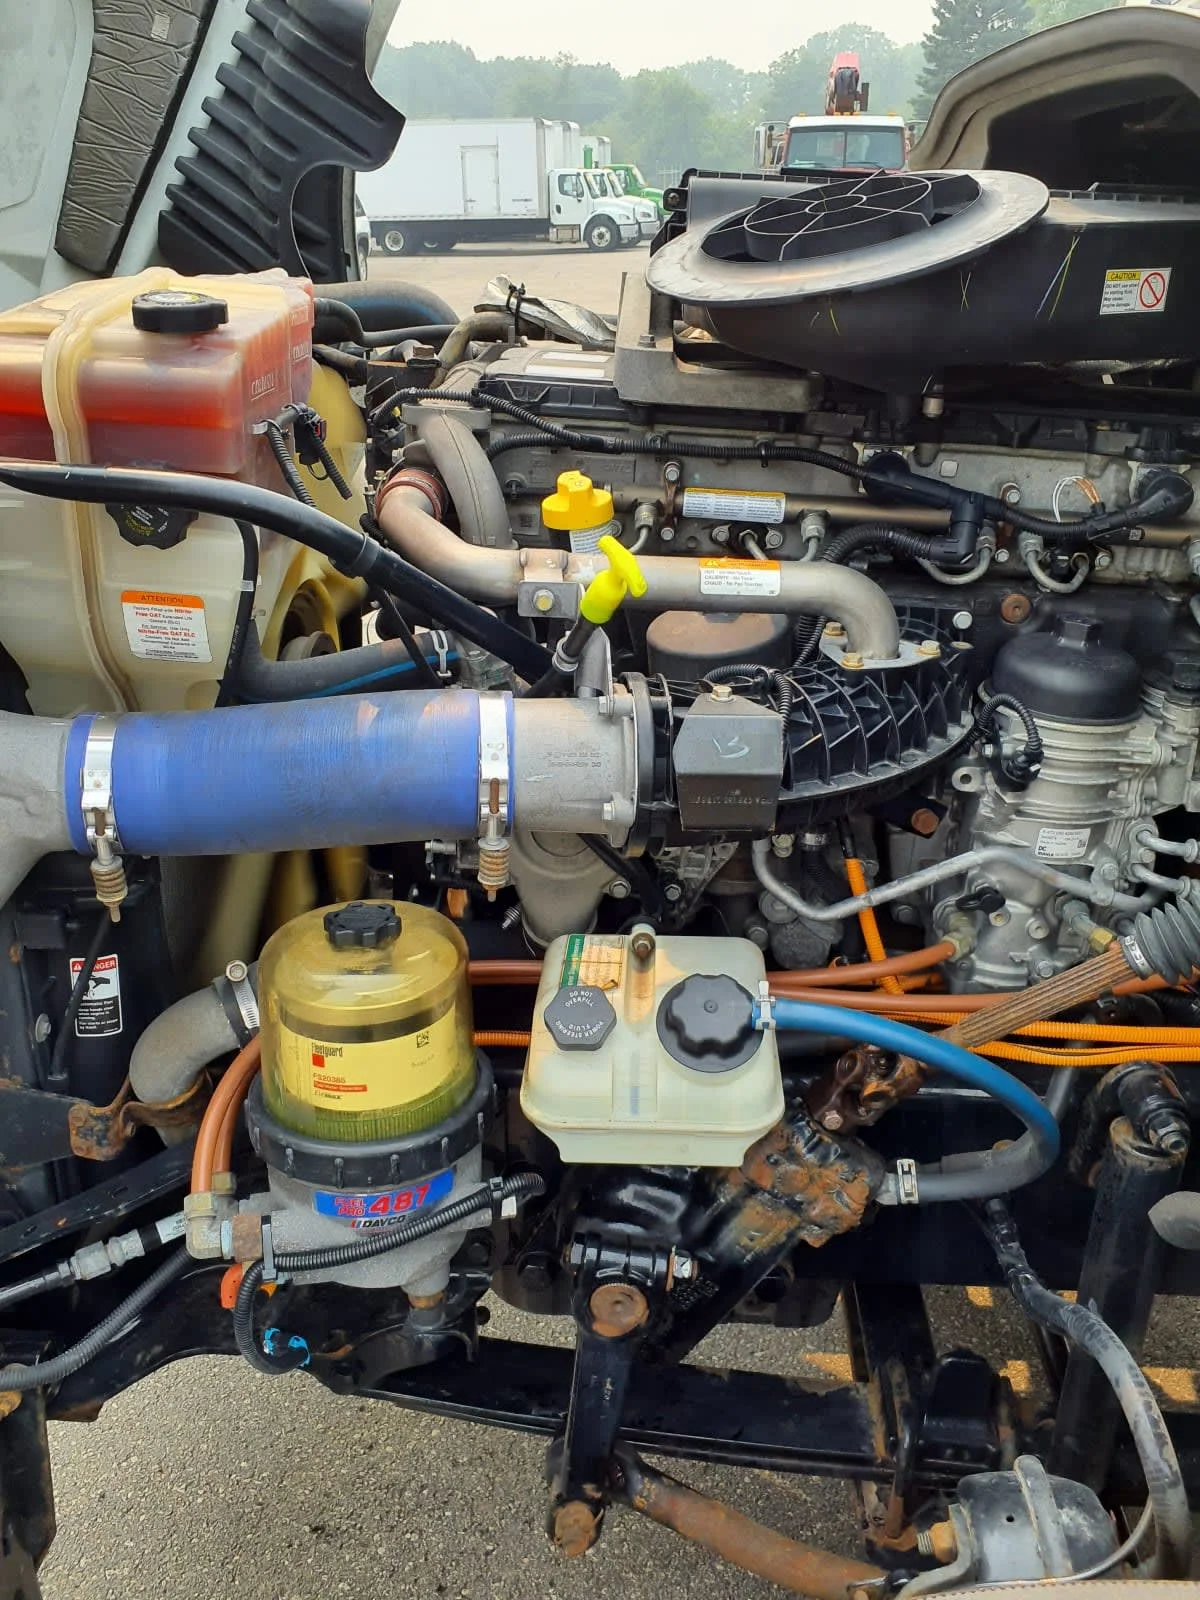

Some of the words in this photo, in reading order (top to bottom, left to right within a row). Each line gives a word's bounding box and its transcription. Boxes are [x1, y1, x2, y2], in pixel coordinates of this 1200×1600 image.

[1110, 271, 1137, 280] CAUTION
[141, 594, 184, 604] ATTENTION
[569, 990, 578, 998] DO
[581, 990, 593, 998] NOT
[565, 996, 595, 1008] OVERFILL
[568, 1023, 591, 1031] FLUID
[311, 1042, 344, 1058] Fleetguard
[335, 1196, 365, 1208] FUEL
[368, 1183, 431, 1216] 487
[338, 1206, 365, 1217] PRO
[362, 1215, 407, 1228] DAVCO
